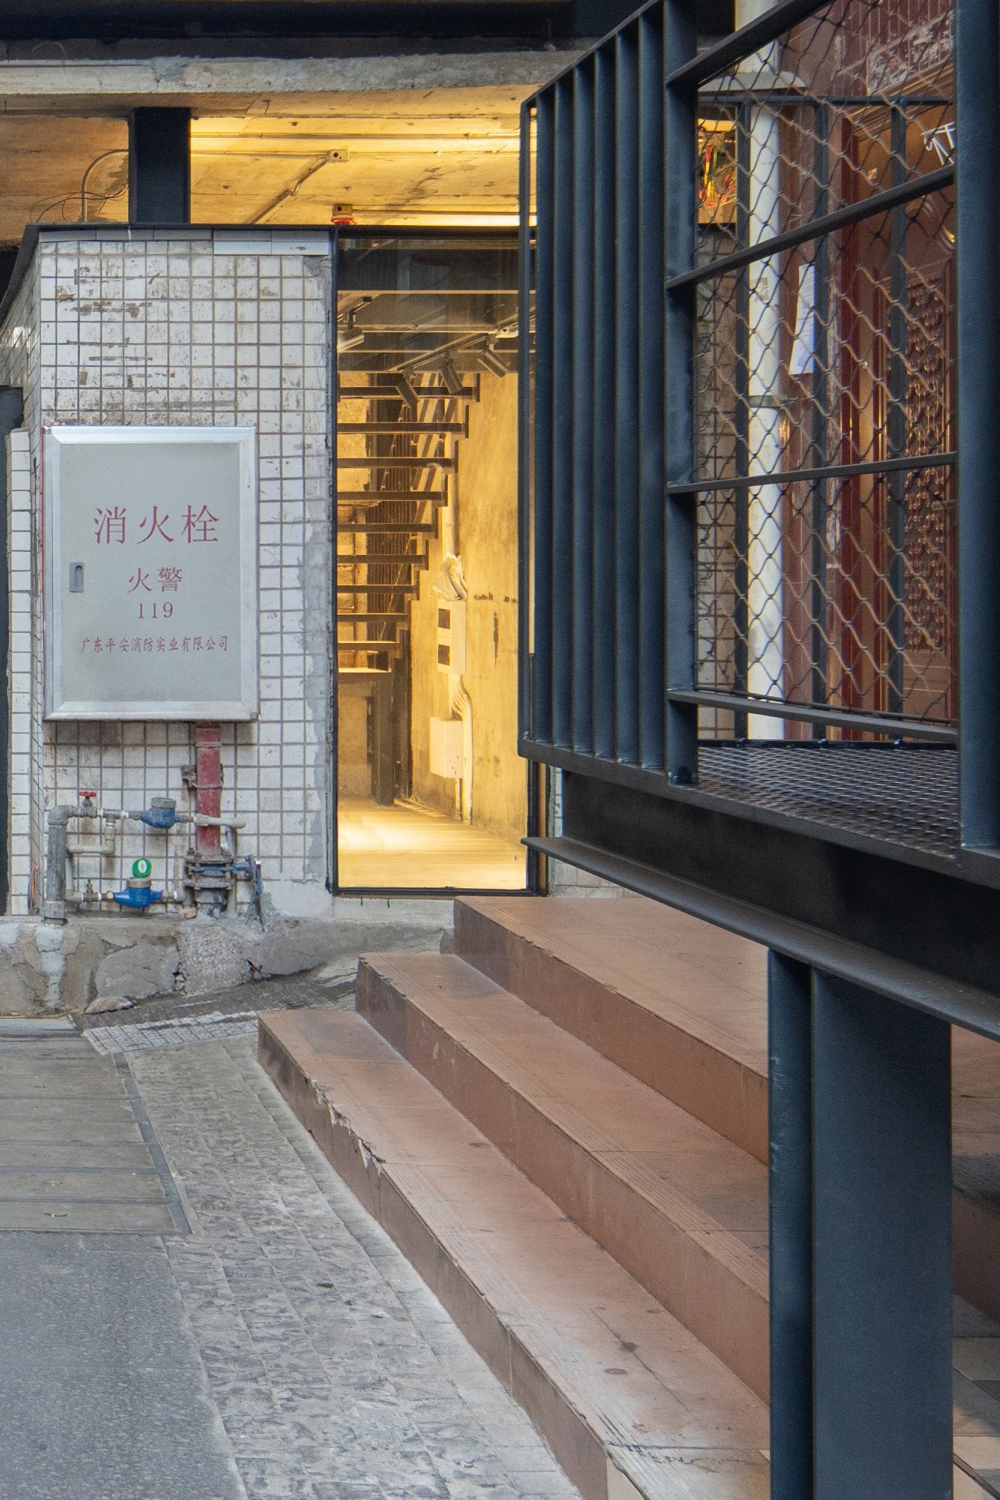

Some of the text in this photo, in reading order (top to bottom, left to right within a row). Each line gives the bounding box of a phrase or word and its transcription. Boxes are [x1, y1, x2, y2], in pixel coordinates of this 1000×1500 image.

[93, 504, 220, 545] 消火栓
[127, 566, 183, 594] 火警
[138, 601, 174, 619] 119
[80, 635, 229, 654] 广东平安消防实业有限公司
